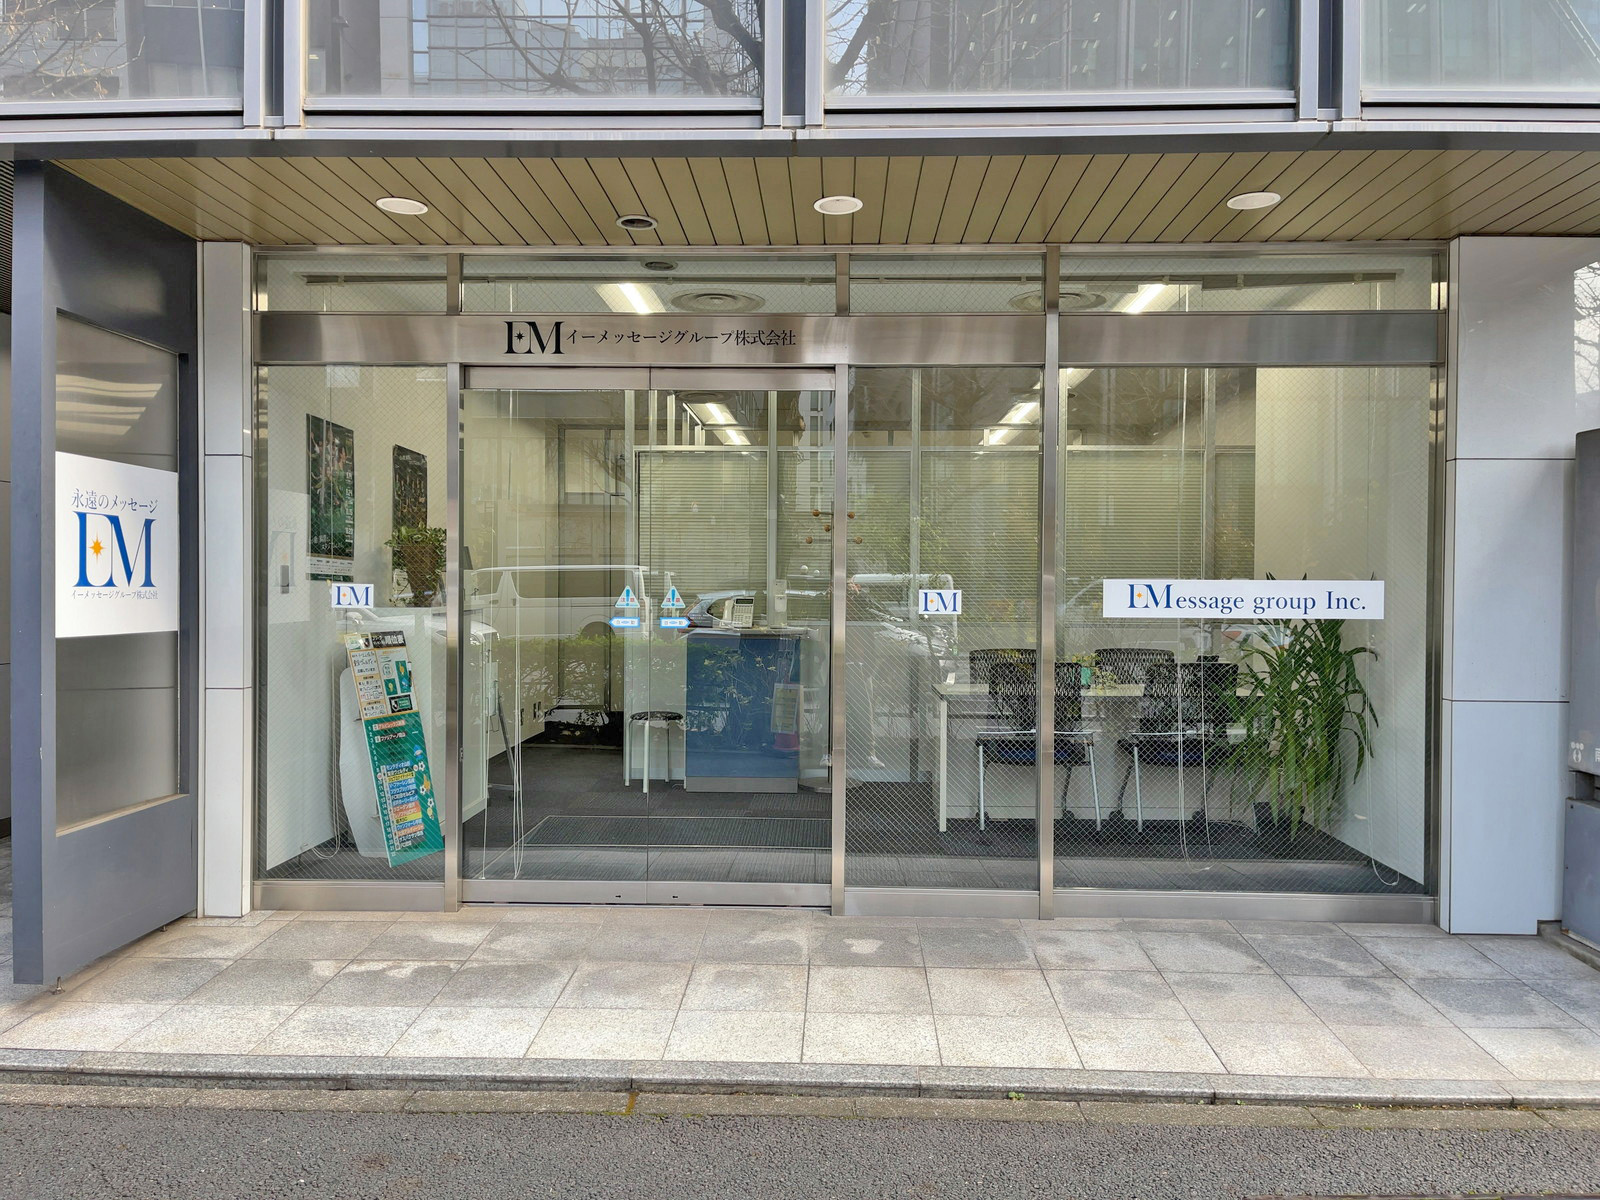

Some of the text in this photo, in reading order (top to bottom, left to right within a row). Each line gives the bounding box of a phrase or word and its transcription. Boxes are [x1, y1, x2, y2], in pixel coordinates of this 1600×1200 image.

[566, 329, 796, 347] イーメッセージグループ株式会社
[71, 487, 159, 514] 永遠のメッセージ
[72, 590, 159, 600] イーメッセージグループ株式会社
[1253, 595, 1316, 614] group
[1325, 590, 1366, 610] Inc.
